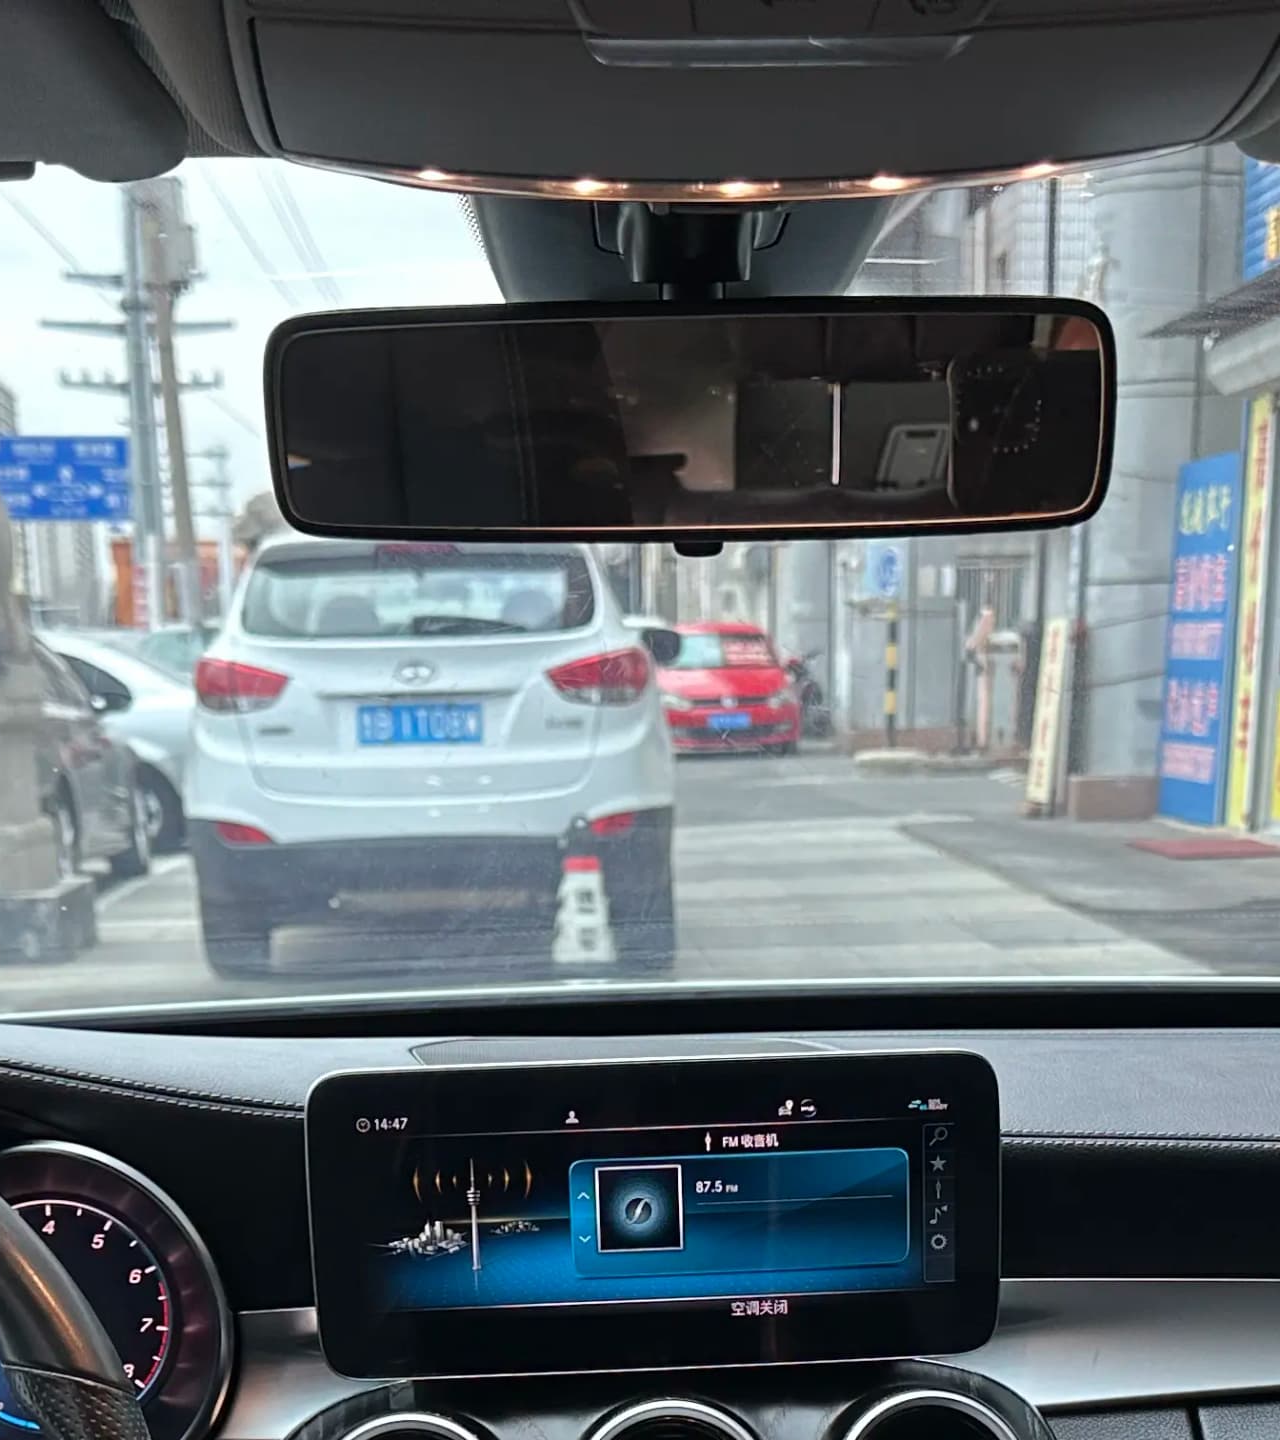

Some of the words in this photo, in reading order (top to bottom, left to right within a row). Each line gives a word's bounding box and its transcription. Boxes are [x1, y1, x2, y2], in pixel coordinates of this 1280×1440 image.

[374, 1117, 408, 1131] 14:47
[722, 1135, 739, 1148] FM
[741, 1133, 779, 1149] 收音机
[695, 1180, 723, 1194] 87.5
[725, 1184, 739, 1193] FM
[42, 1219, 56, 1235] 4
[90, 1234, 105, 1250] 5
[129, 1268, 143, 1284] 6
[731, 1300, 789, 1317] 空调关闭
[141, 1318, 154, 1332] 7
